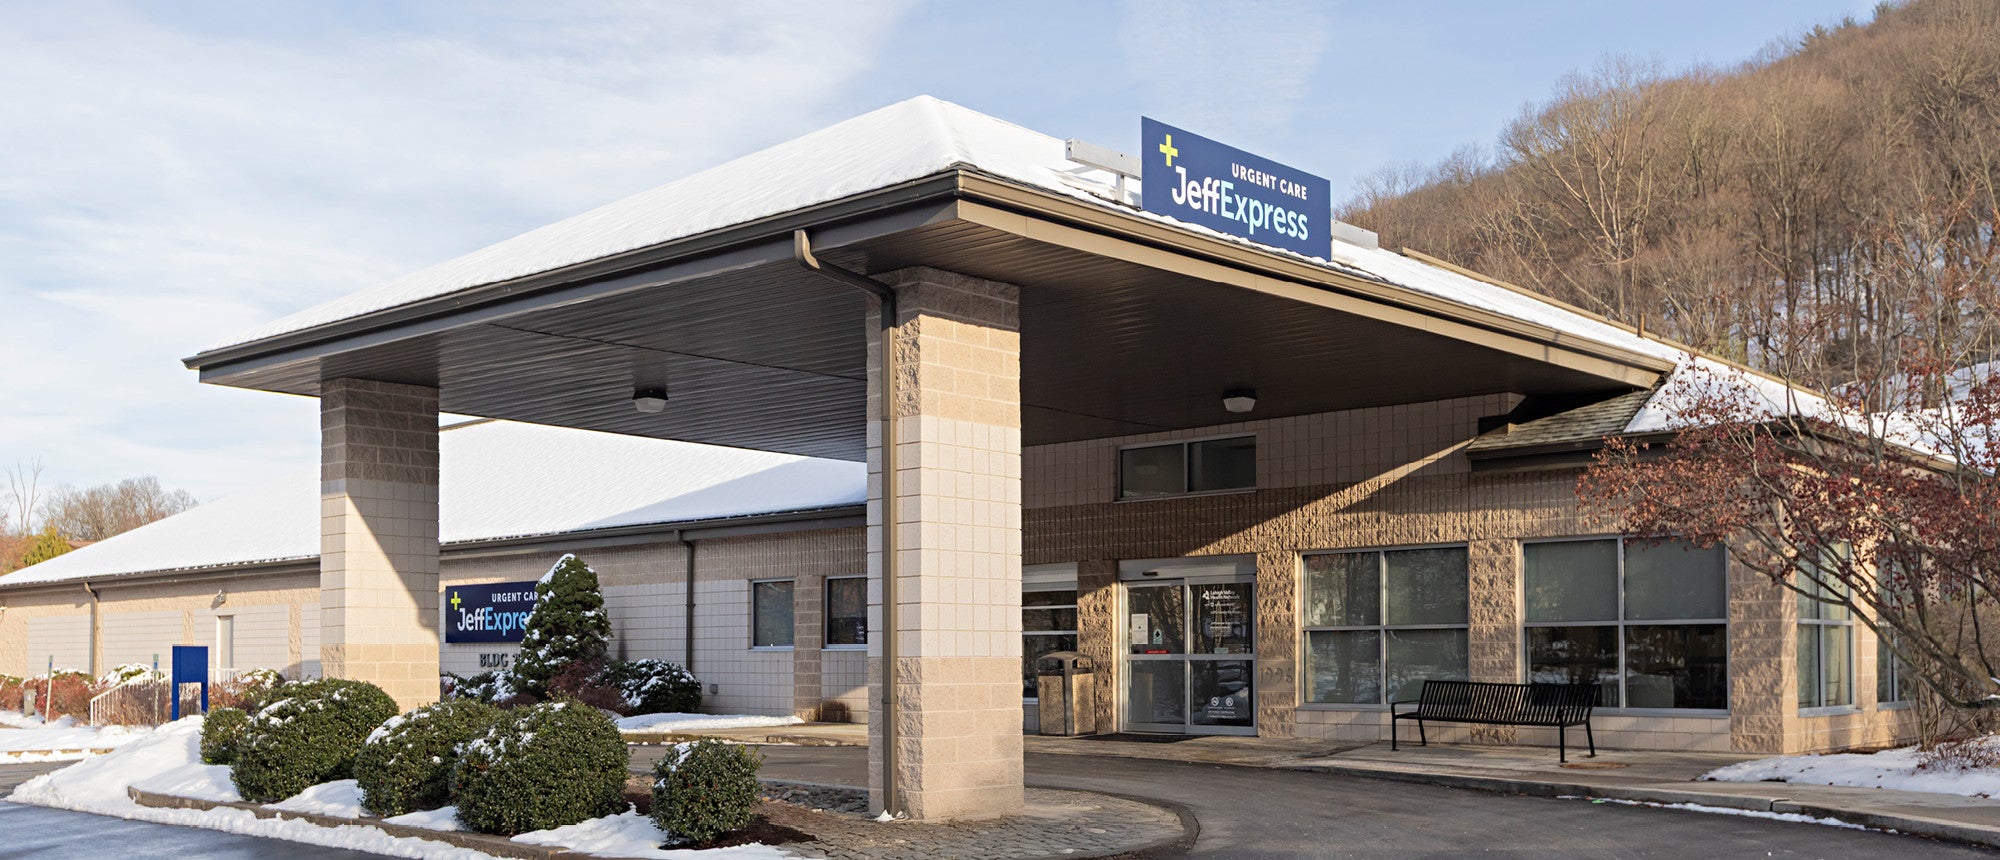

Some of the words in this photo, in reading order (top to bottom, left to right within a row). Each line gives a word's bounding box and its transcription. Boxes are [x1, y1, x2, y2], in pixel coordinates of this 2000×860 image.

[1231, 162, 1277, 190] URGENT
[1279, 179, 1308, 200] CARE
[1171, 165, 1309, 241] JeffExpress
[491, 591, 522, 603] URGENT
[523, 591, 539, 602] CAR
[457, 606, 533, 637] JeffExpre
[479, 653, 509, 668] BLDG
